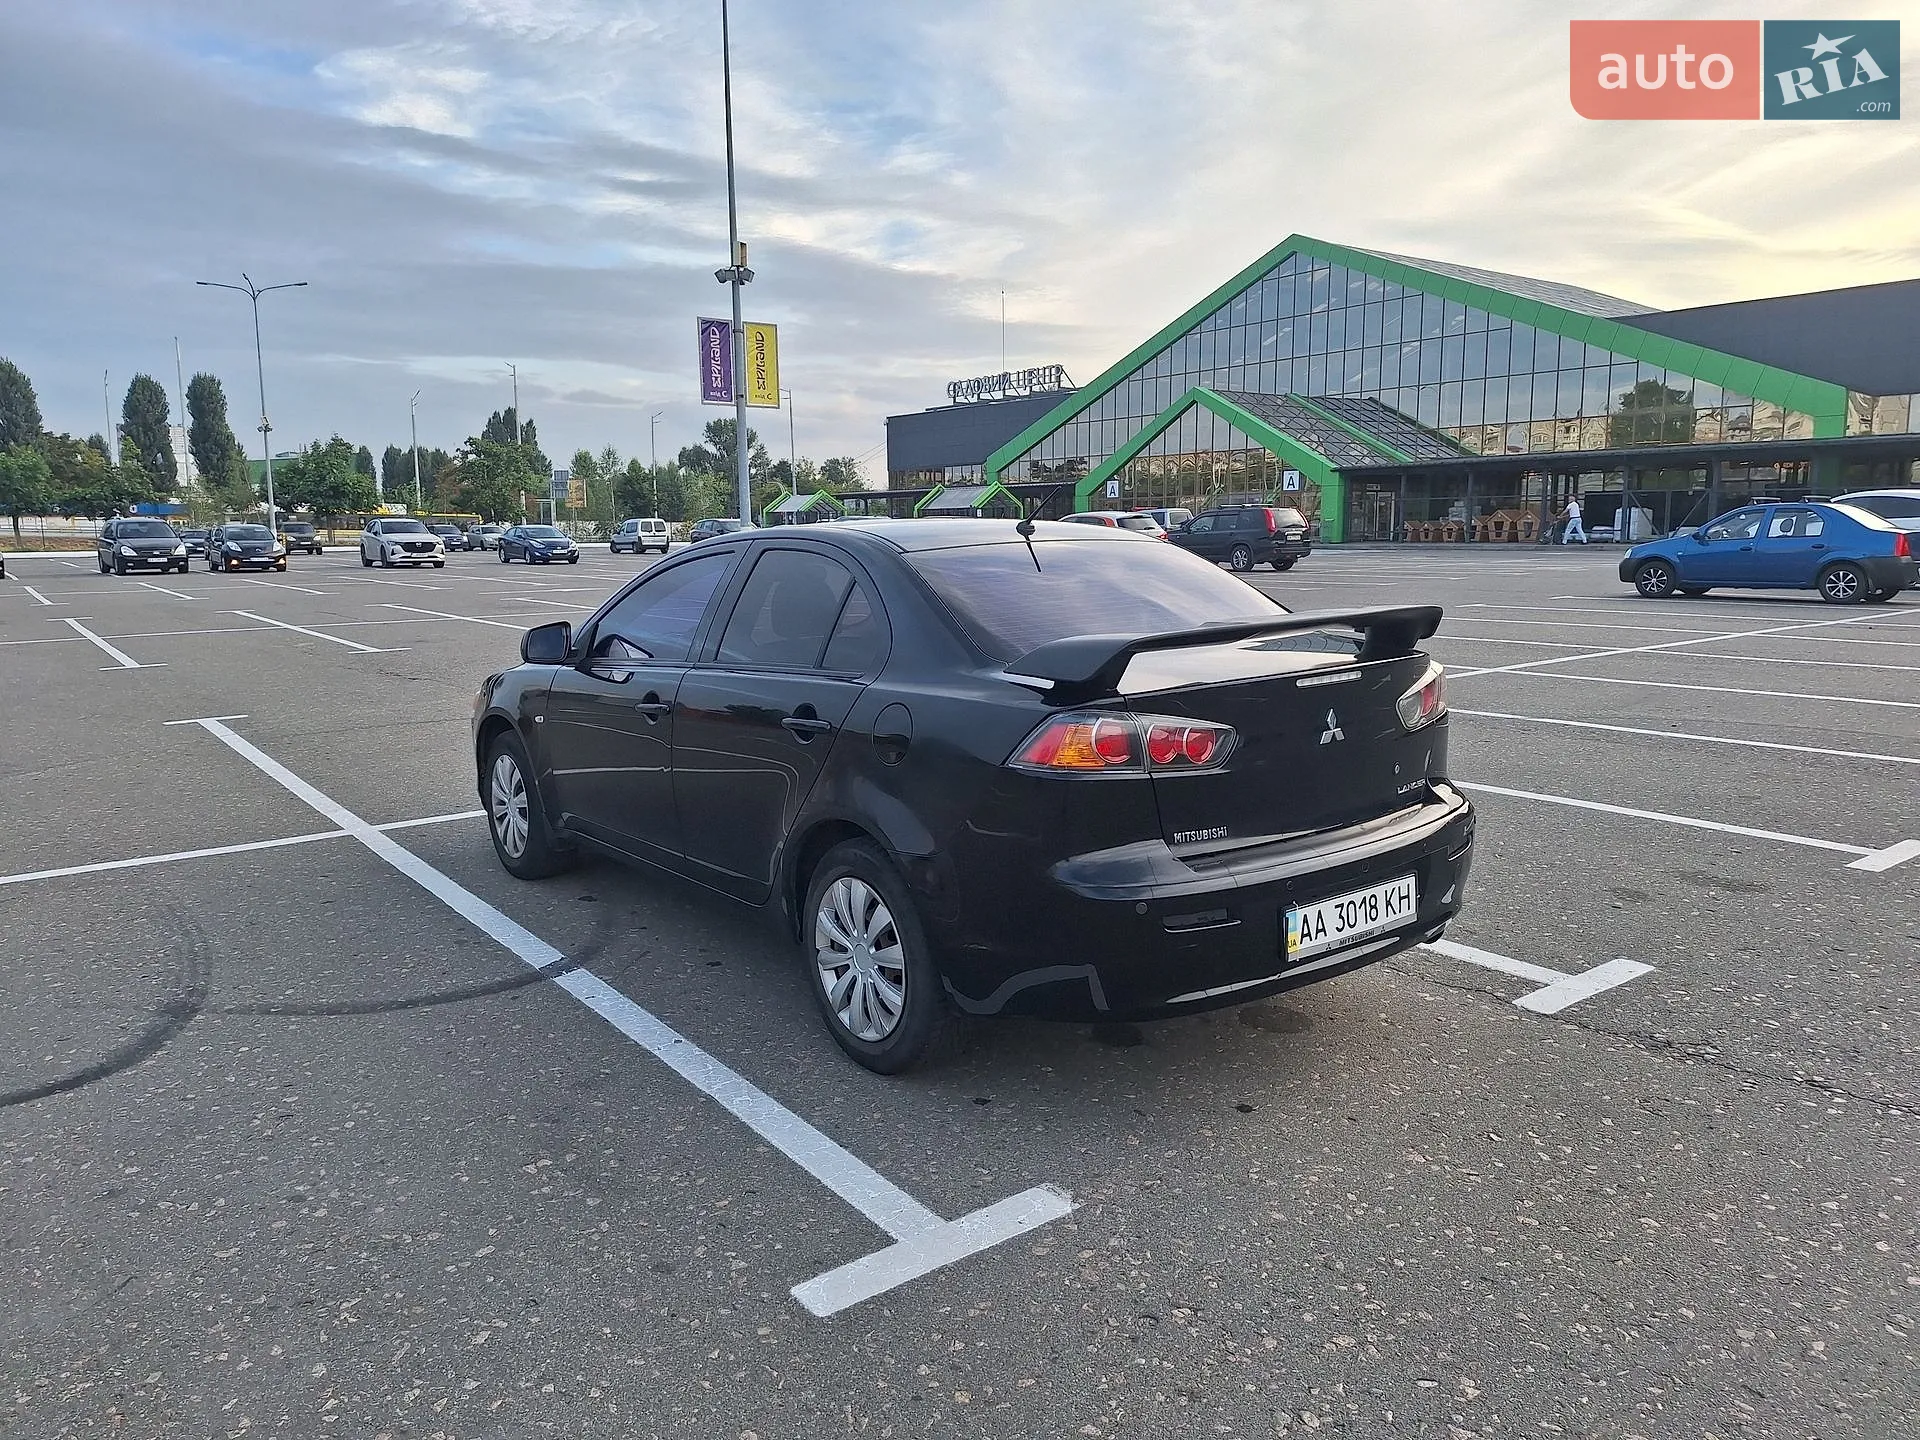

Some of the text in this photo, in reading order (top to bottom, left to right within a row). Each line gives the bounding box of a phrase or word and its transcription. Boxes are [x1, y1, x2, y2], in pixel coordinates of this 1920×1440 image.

[947, 364, 1062, 399] САДОВИЙ ЦЕНТР
[1397, 778, 1426, 794] LANCER
[1173, 826, 1228, 843] MITSUBISHI
[1300, 883, 1411, 945] AA 3018 KH
[1339, 929, 1375, 946] MITSUBISHI
